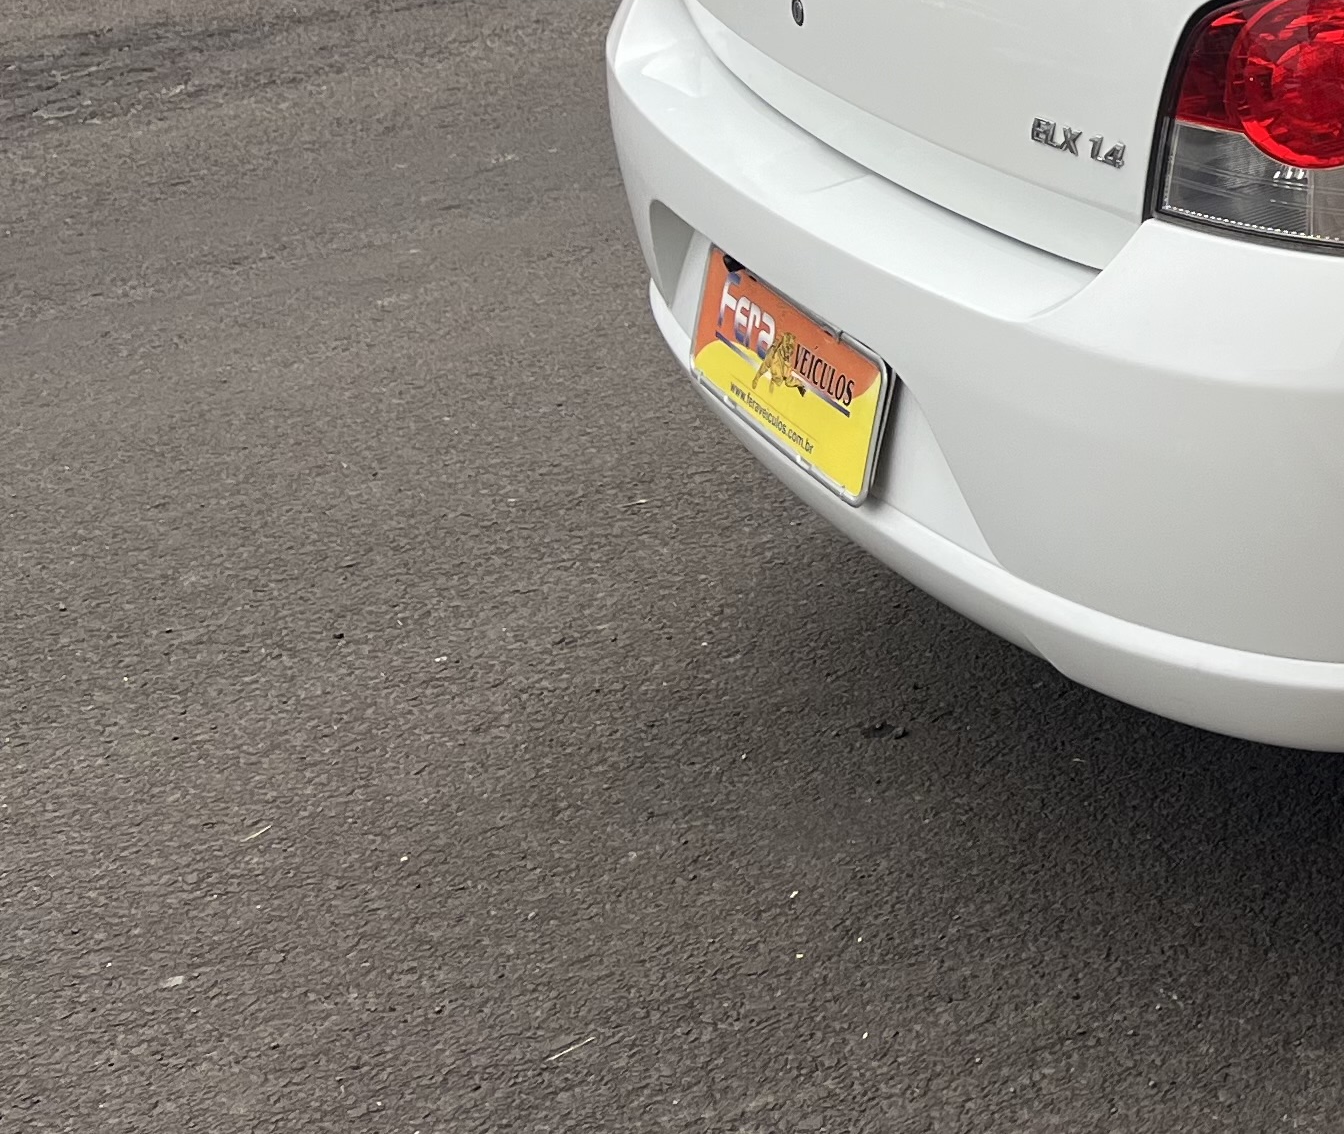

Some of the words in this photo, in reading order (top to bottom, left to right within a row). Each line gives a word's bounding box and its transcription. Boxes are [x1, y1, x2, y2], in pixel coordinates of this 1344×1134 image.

[1031, 116, 1083, 157] ELX
[716, 270, 777, 360] Fera
[793, 343, 856, 408] VEÍCULOS
[729, 380, 815, 456] www.feraveiculos.com.br
